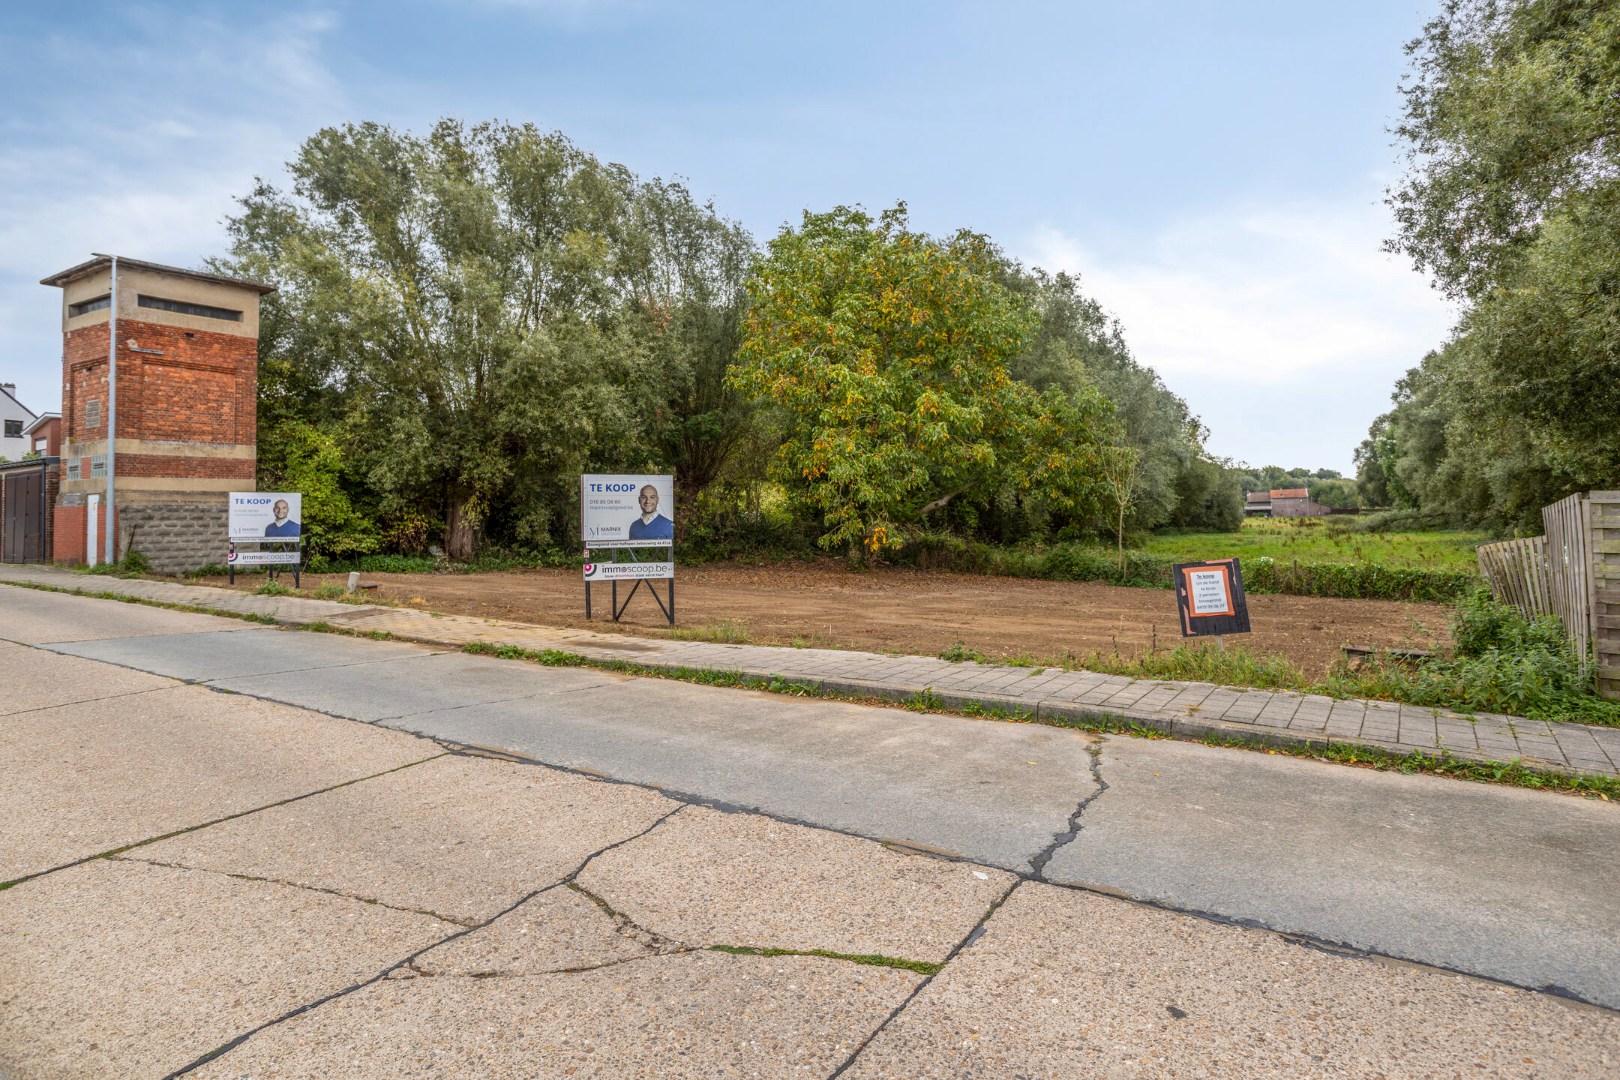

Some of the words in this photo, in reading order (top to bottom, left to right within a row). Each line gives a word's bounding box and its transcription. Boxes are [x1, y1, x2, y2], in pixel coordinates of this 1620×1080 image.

[590, 484, 602, 492] TE
[606, 484, 636, 492] KOOP
[602, 564, 668, 573] immoscoop.be
